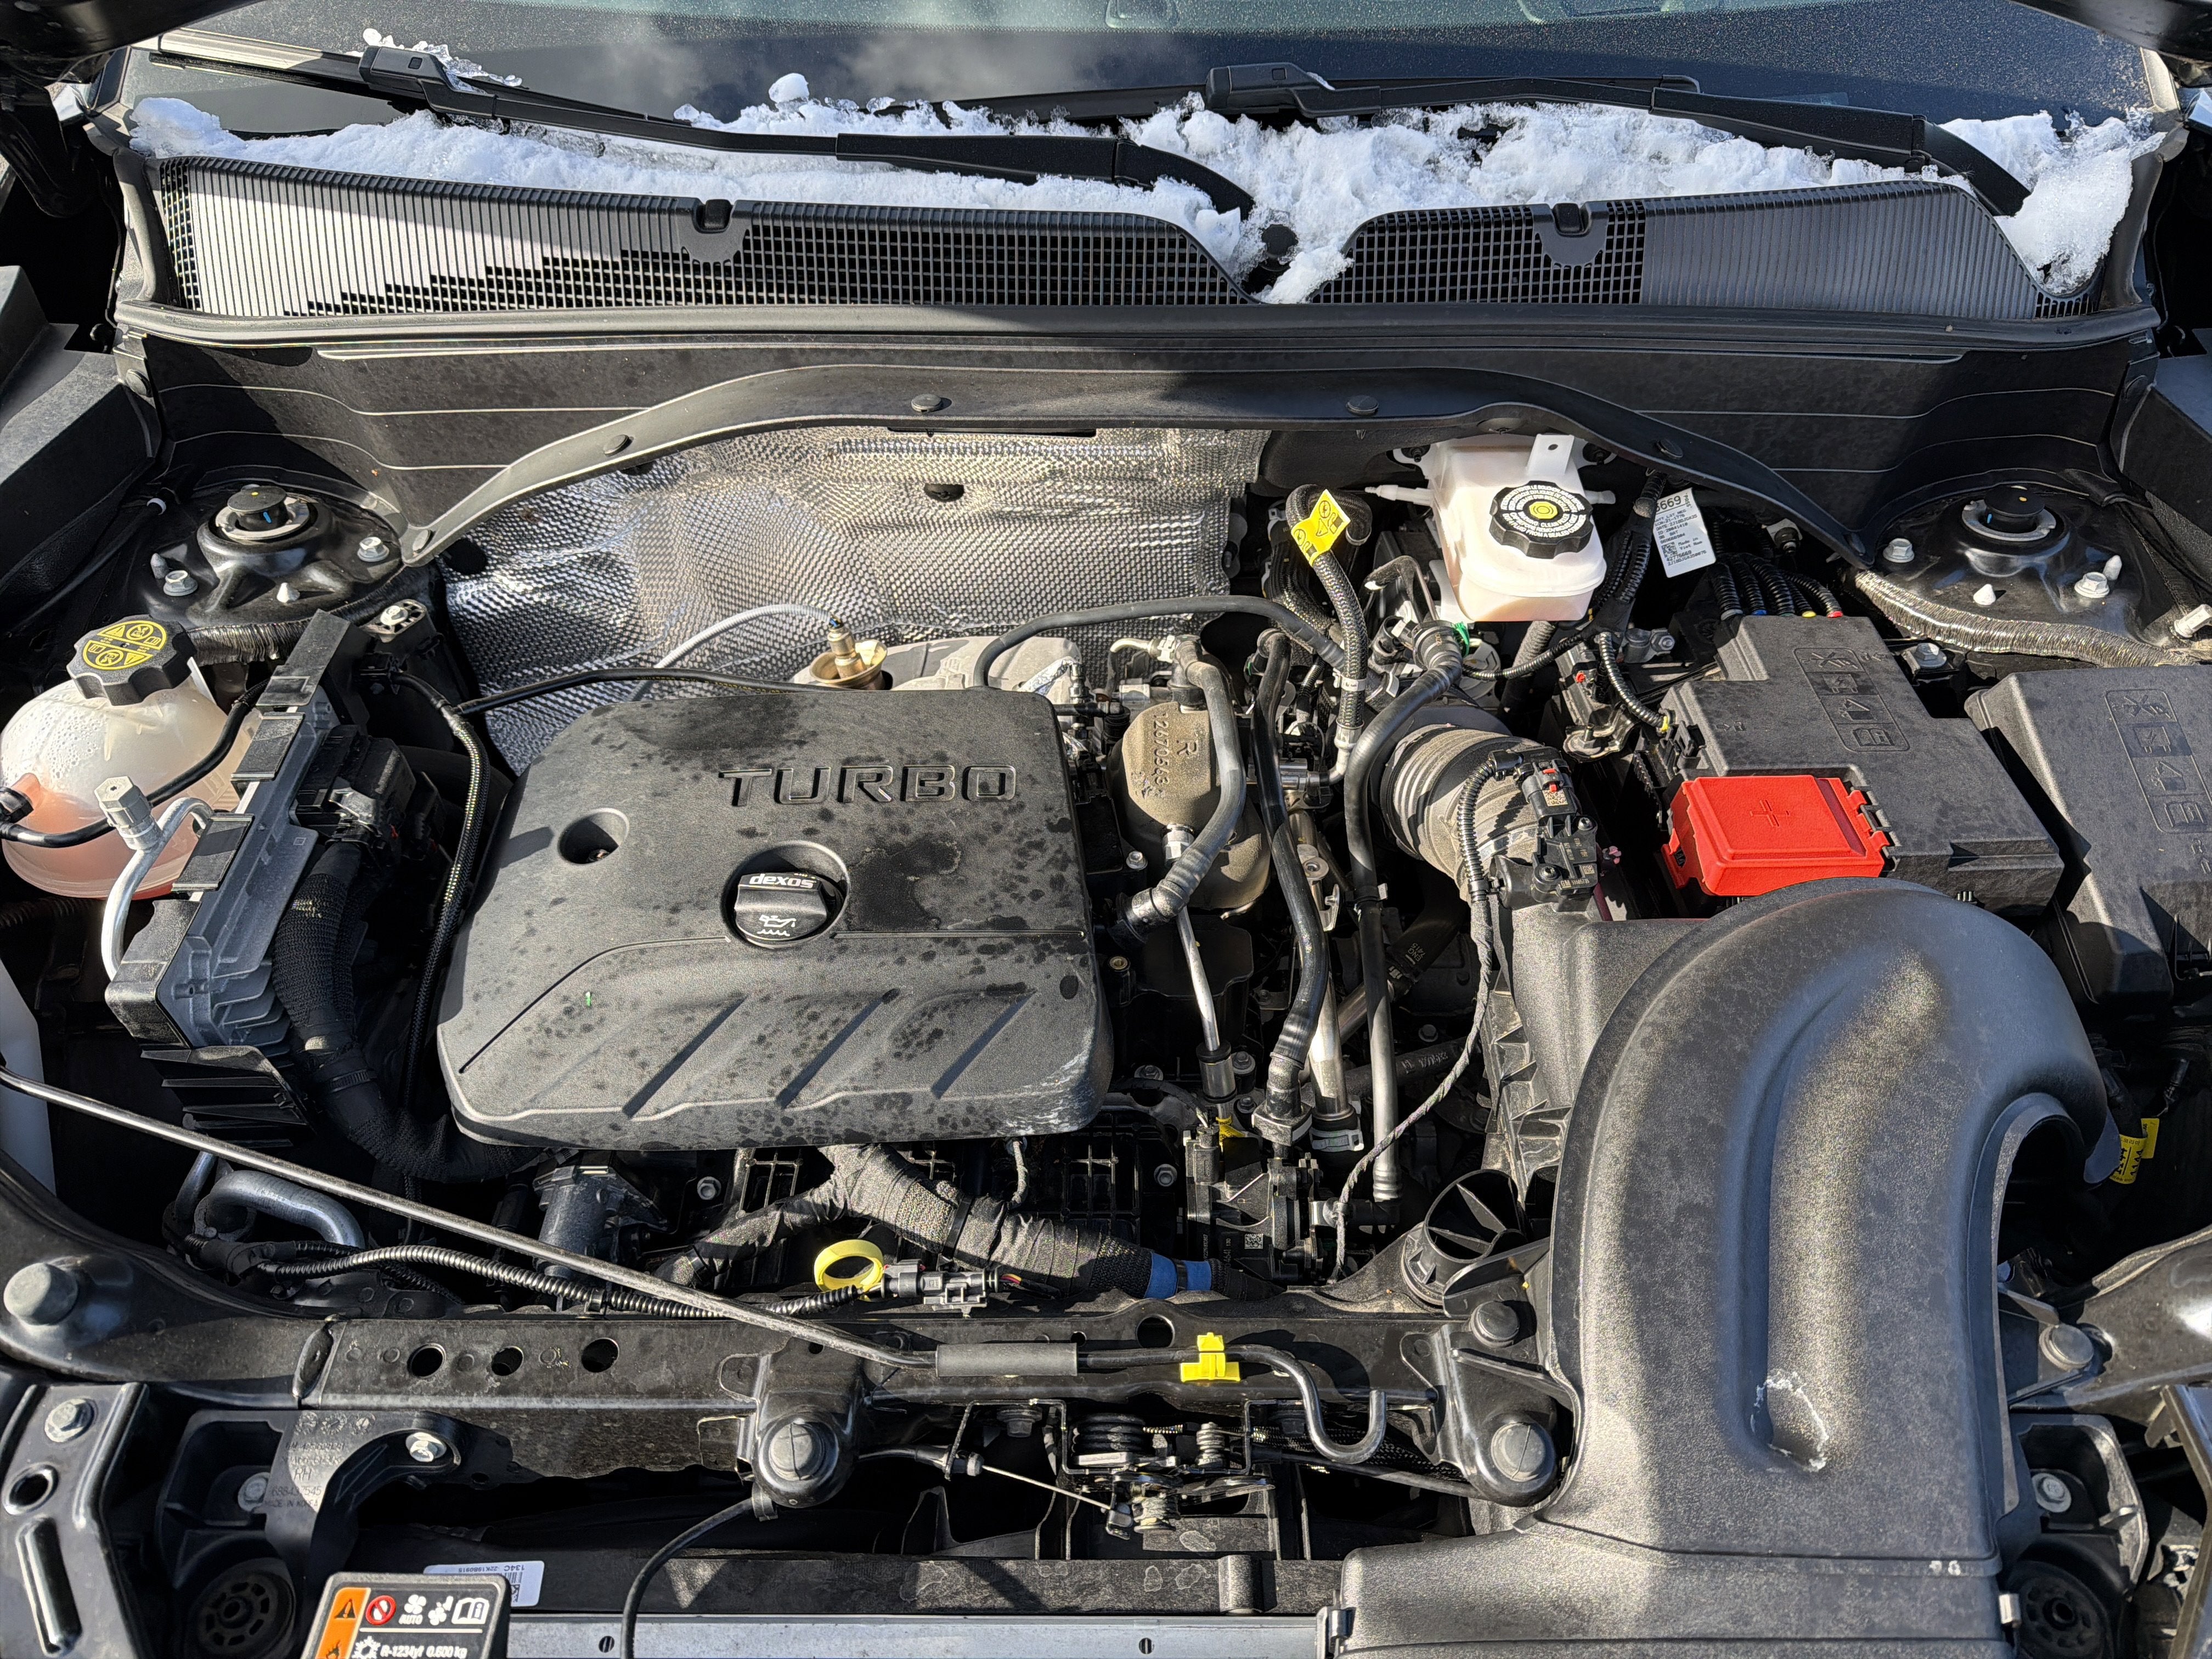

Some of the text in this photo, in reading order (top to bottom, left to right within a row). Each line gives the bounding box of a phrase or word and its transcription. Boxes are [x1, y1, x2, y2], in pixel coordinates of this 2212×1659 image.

[1177, 740, 1198, 757] R
[718, 765, 1017, 806] TURBO
[749, 873, 816, 888] dexos
[1408, 948, 1421, 962] ENG
[2130, 1149, 2143, 1176] 1144
[294, 1467, 312, 1481] RH
[398, 1615, 424, 1625] AUTO
[454, 1645, 467, 1659] kg
